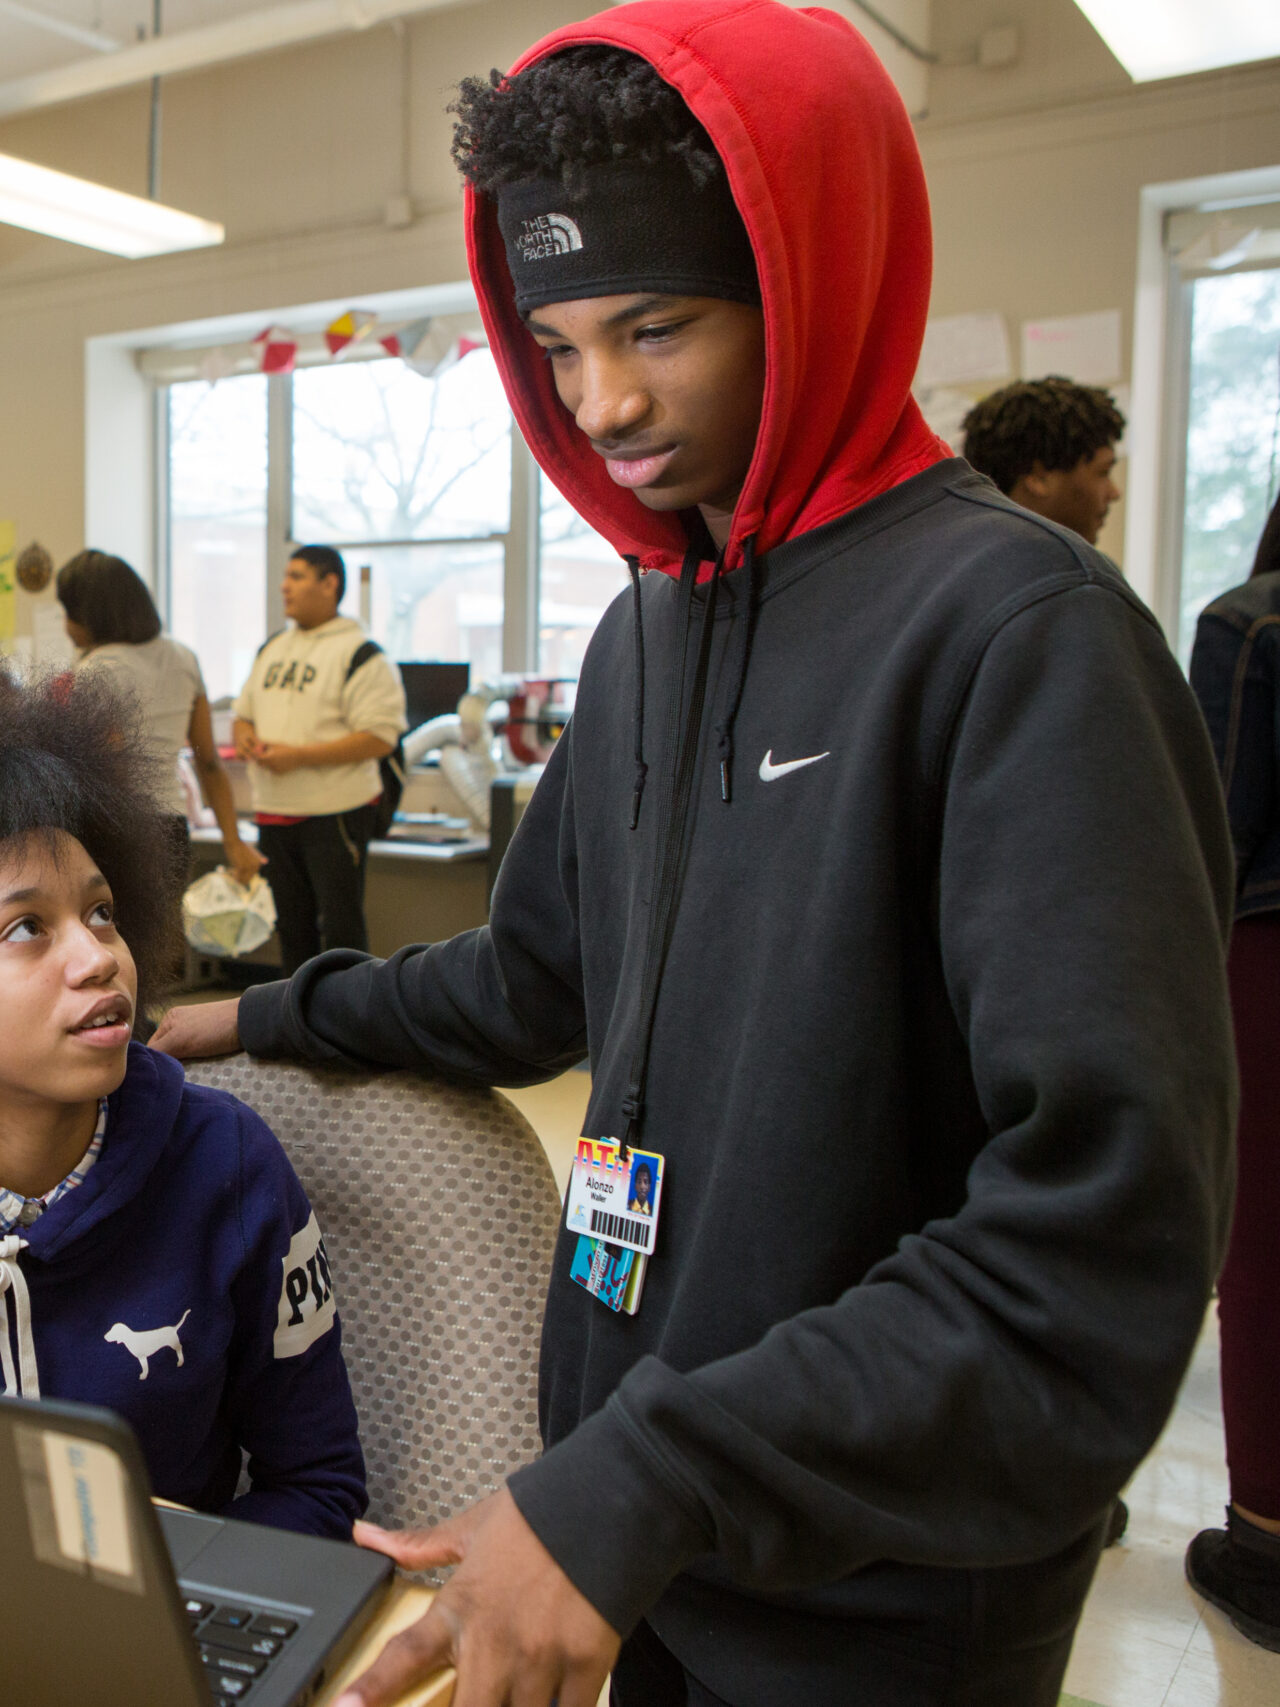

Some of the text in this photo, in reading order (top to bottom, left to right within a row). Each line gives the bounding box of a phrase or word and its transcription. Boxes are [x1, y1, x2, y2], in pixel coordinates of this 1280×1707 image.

[521, 216, 549, 233] THE
[514, 228, 552, 250] NORTH
[523, 243, 554, 262] FACE
[263, 660, 317, 692] GAP
[586, 1177, 614, 1194] Alonzo
